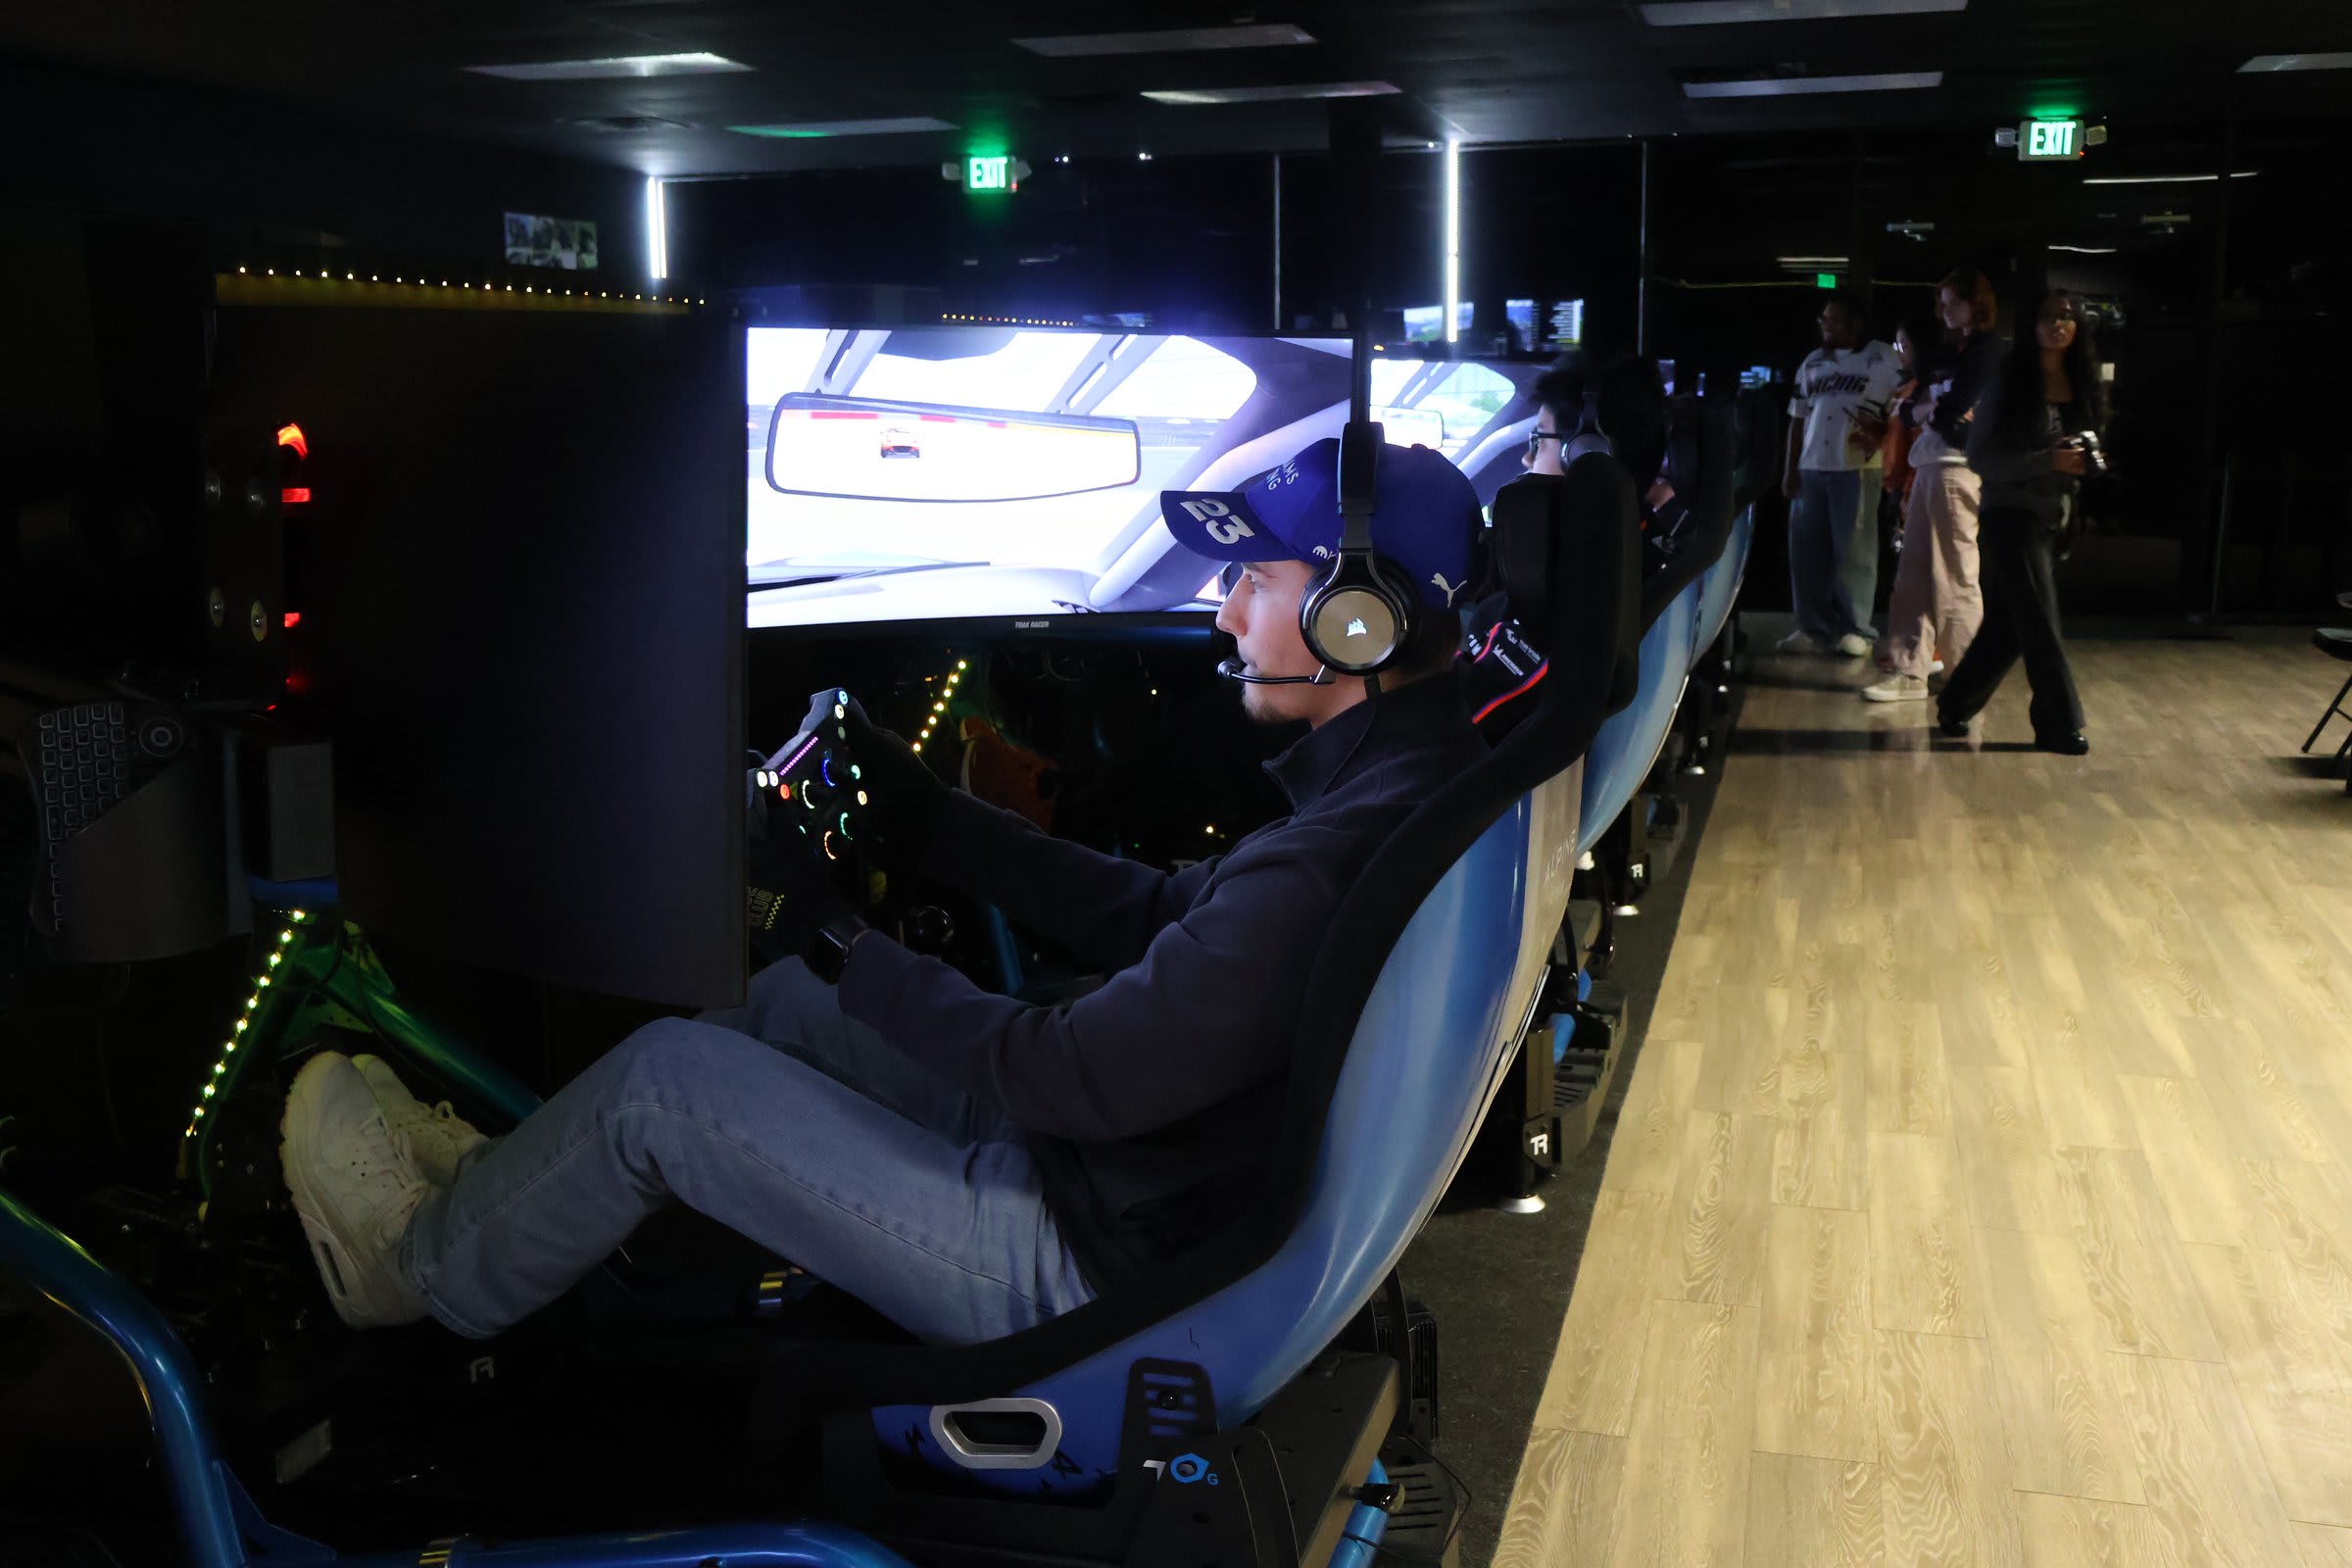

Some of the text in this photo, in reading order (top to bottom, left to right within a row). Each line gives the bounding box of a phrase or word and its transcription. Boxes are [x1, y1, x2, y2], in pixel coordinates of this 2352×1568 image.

[2029, 122, 2076, 155] EXIT
[971, 157, 1007, 188] EXIT
[1180, 498, 1255, 545] 23
